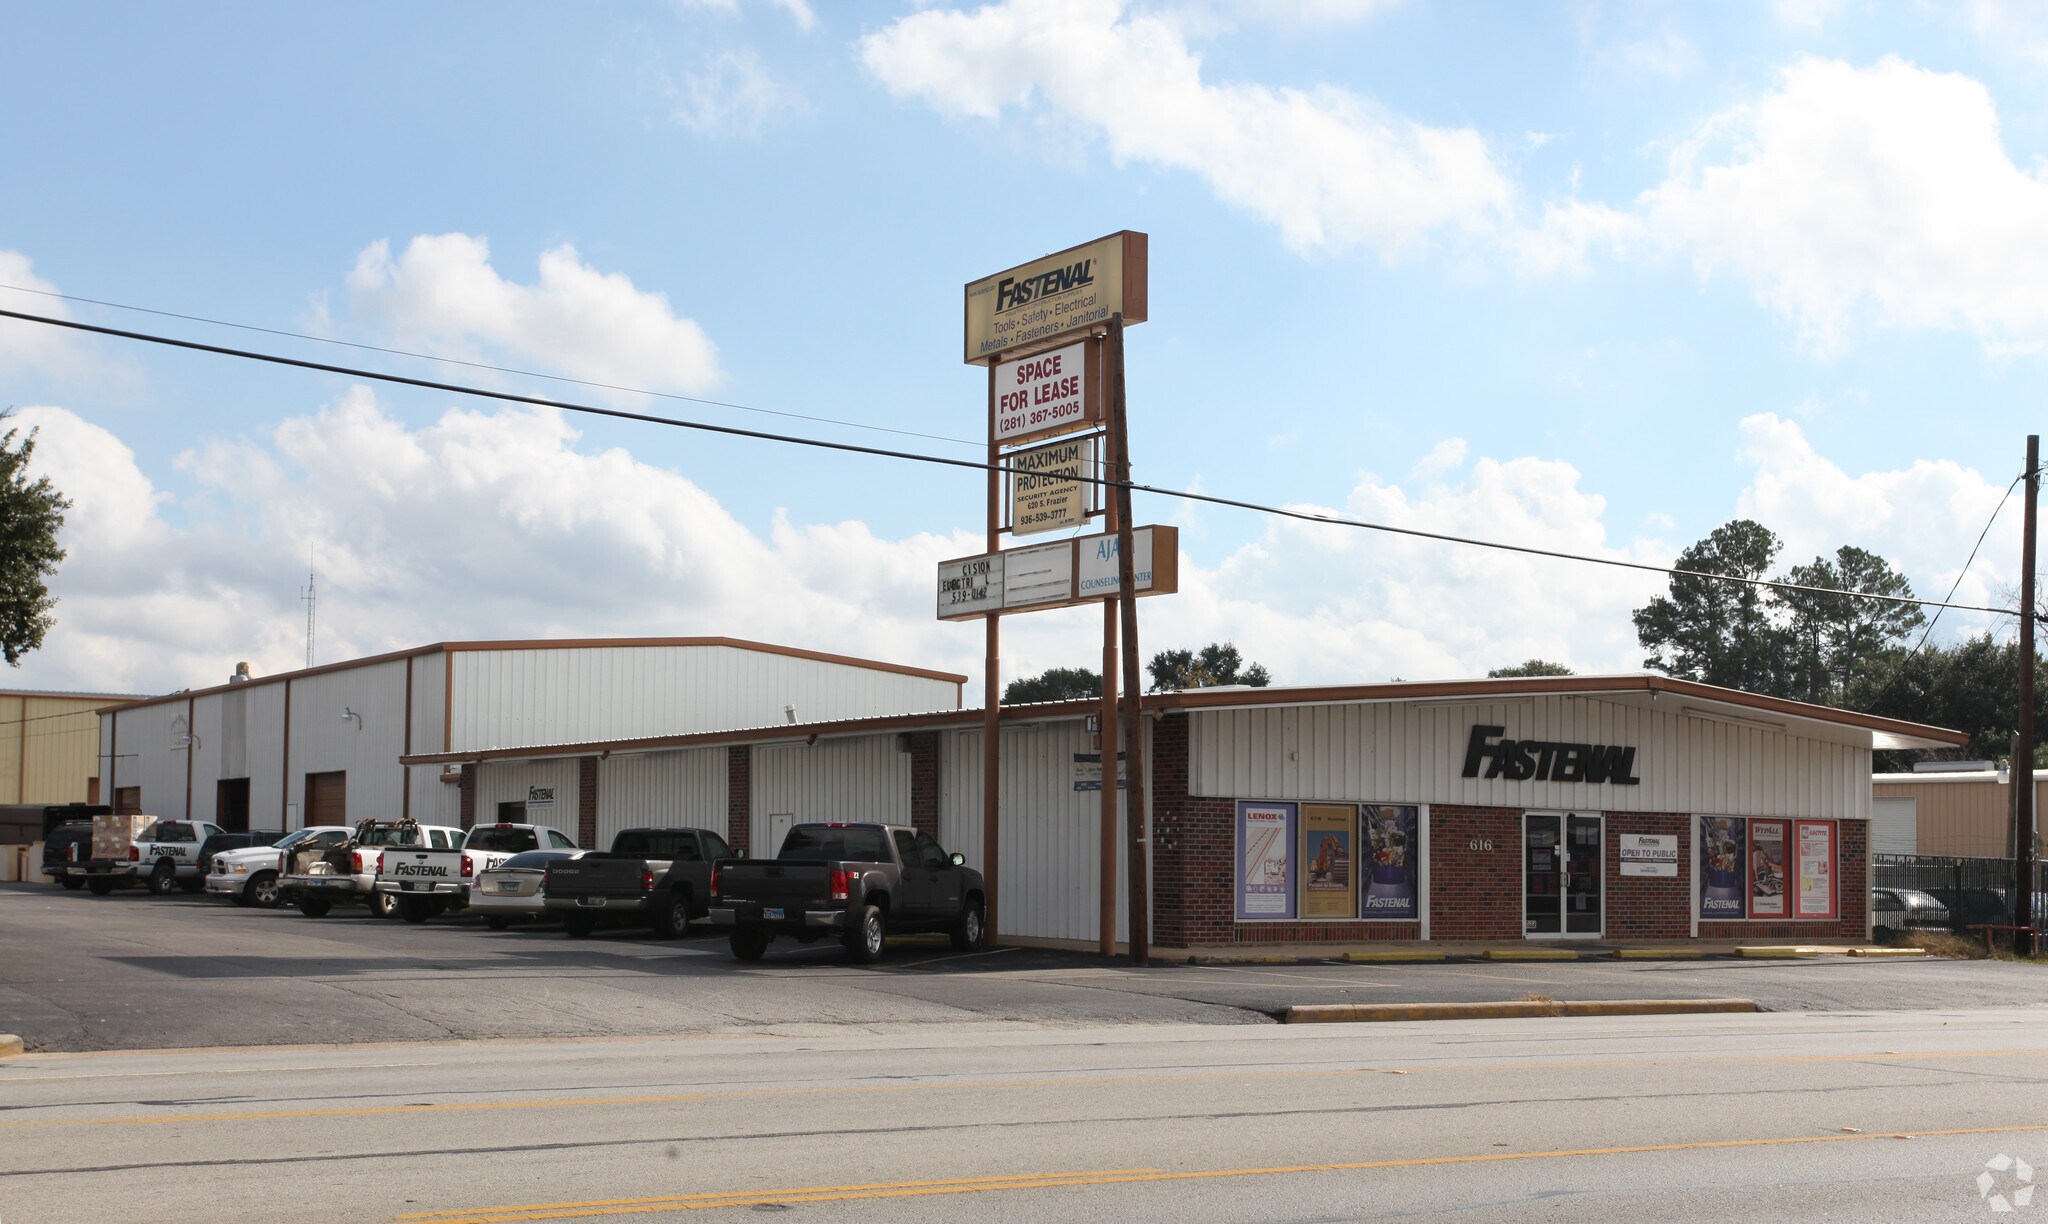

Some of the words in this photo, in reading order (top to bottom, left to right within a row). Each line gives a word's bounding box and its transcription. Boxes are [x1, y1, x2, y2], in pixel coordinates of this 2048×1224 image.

[996, 258, 1095, 312] FASTENAL
[994, 319, 1016, 334] Tools
[1021, 308, 1048, 326] Safety
[1054, 293, 1097, 316] Electrical
[980, 337, 1008, 353] Metals
[1016, 322, 1059, 342] Fasteners
[1066, 304, 1109, 327] Janitorial
[1016, 355, 1062, 385] SPACE
[1000, 389, 1028, 414] FOR
[1034, 375, 1079, 405] LEASE
[1000, 414, 1026, 433] (281)
[1029, 401, 1079, 425] 367-5005
[1017, 445, 1078, 470] MAXIMUM
[1017, 465, 1078, 492] PROTECTION
[1017, 491, 1048, 502] SECURITY
[1049, 485, 1079, 496] AGENCY
[1027, 501, 1038, 510] 620
[1039, 500, 1046, 508] S.
[1046, 496, 1068, 507] Frazier
[1020, 508, 1067, 525] 936-539-3777
[1096, 537, 1122, 562] AJA
[1134, 571, 1152, 582] NTER
[1462, 725, 1641, 785] FASTENAL
[528, 785, 554, 801] FASTENAL
[149, 844, 187, 857] FASTENAL
[1469, 839, 1492, 851] 616
[1622, 849, 1640, 857] OPEN
[1642, 849, 1651, 857] TO
[1652, 850, 1677, 858] PUBLIC
[394, 862, 449, 877] FASTENAL
[1366, 895, 1411, 908] FASTENAL
[1703, 897, 1740, 909] FASTENAL
